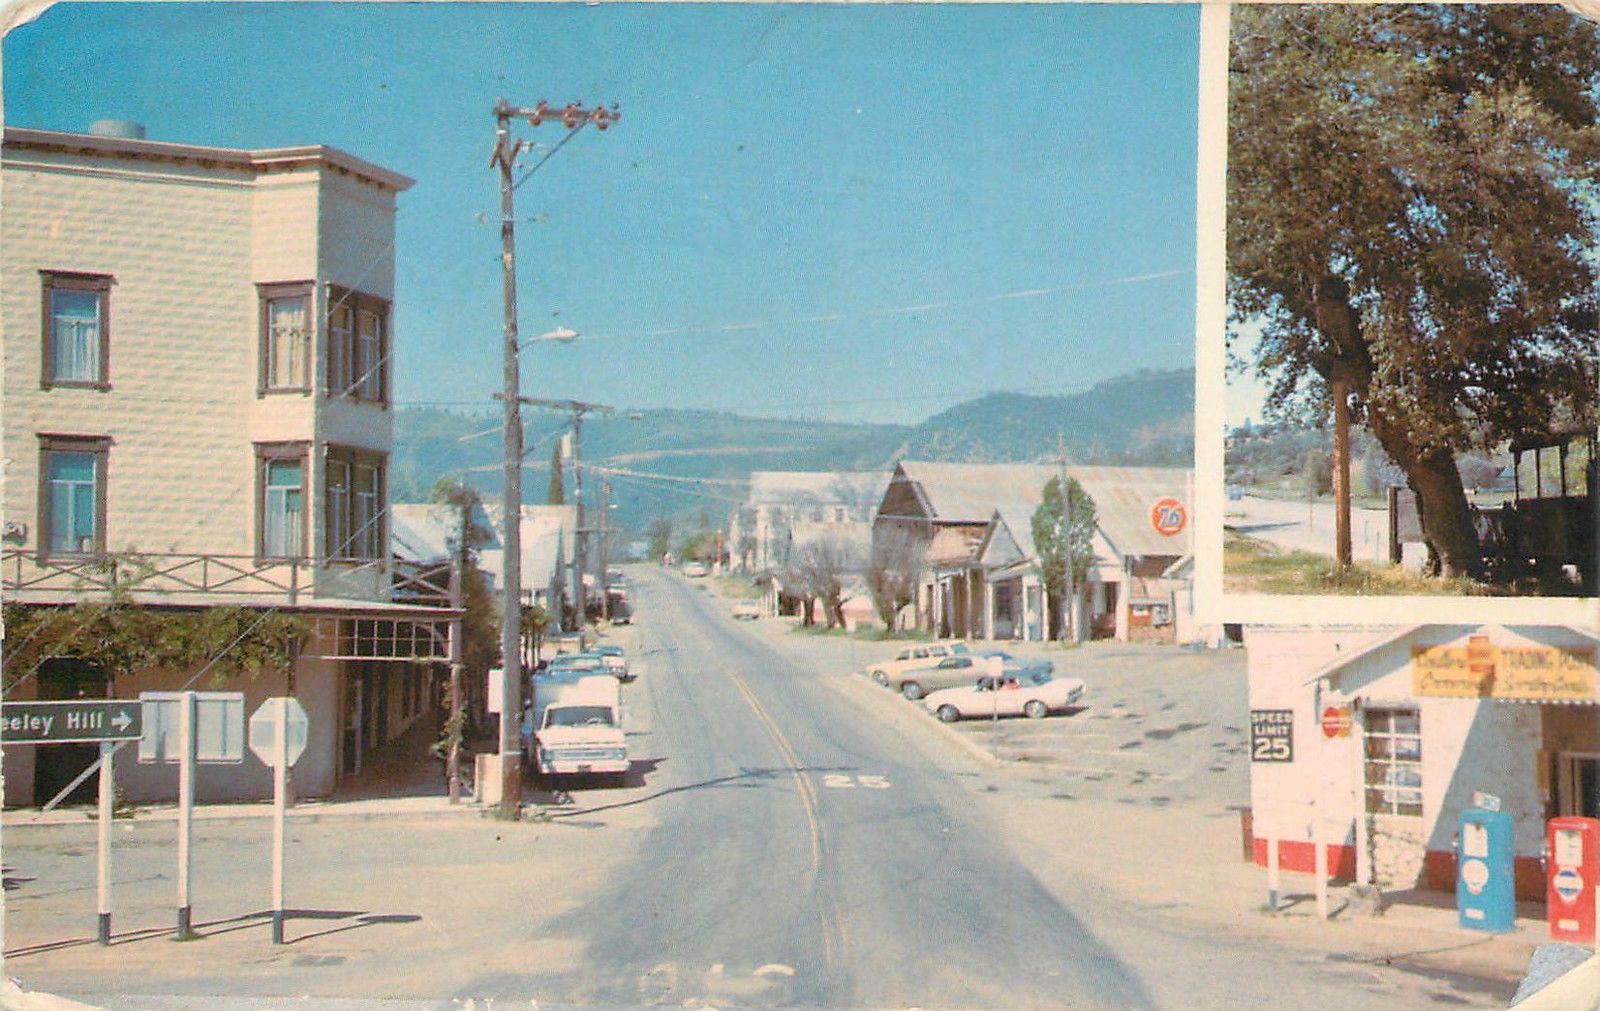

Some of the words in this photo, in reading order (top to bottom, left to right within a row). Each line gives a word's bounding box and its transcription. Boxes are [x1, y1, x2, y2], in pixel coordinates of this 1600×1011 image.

[1159, 506, 1182, 529] 76
[66, 711, 104, 730] Hill
[1250, 712, 1292, 723] SPEED
[1254, 725, 1289, 736] LIMIT
[1253, 738, 1290, 759] 25
[822, 774, 891, 788] 25
